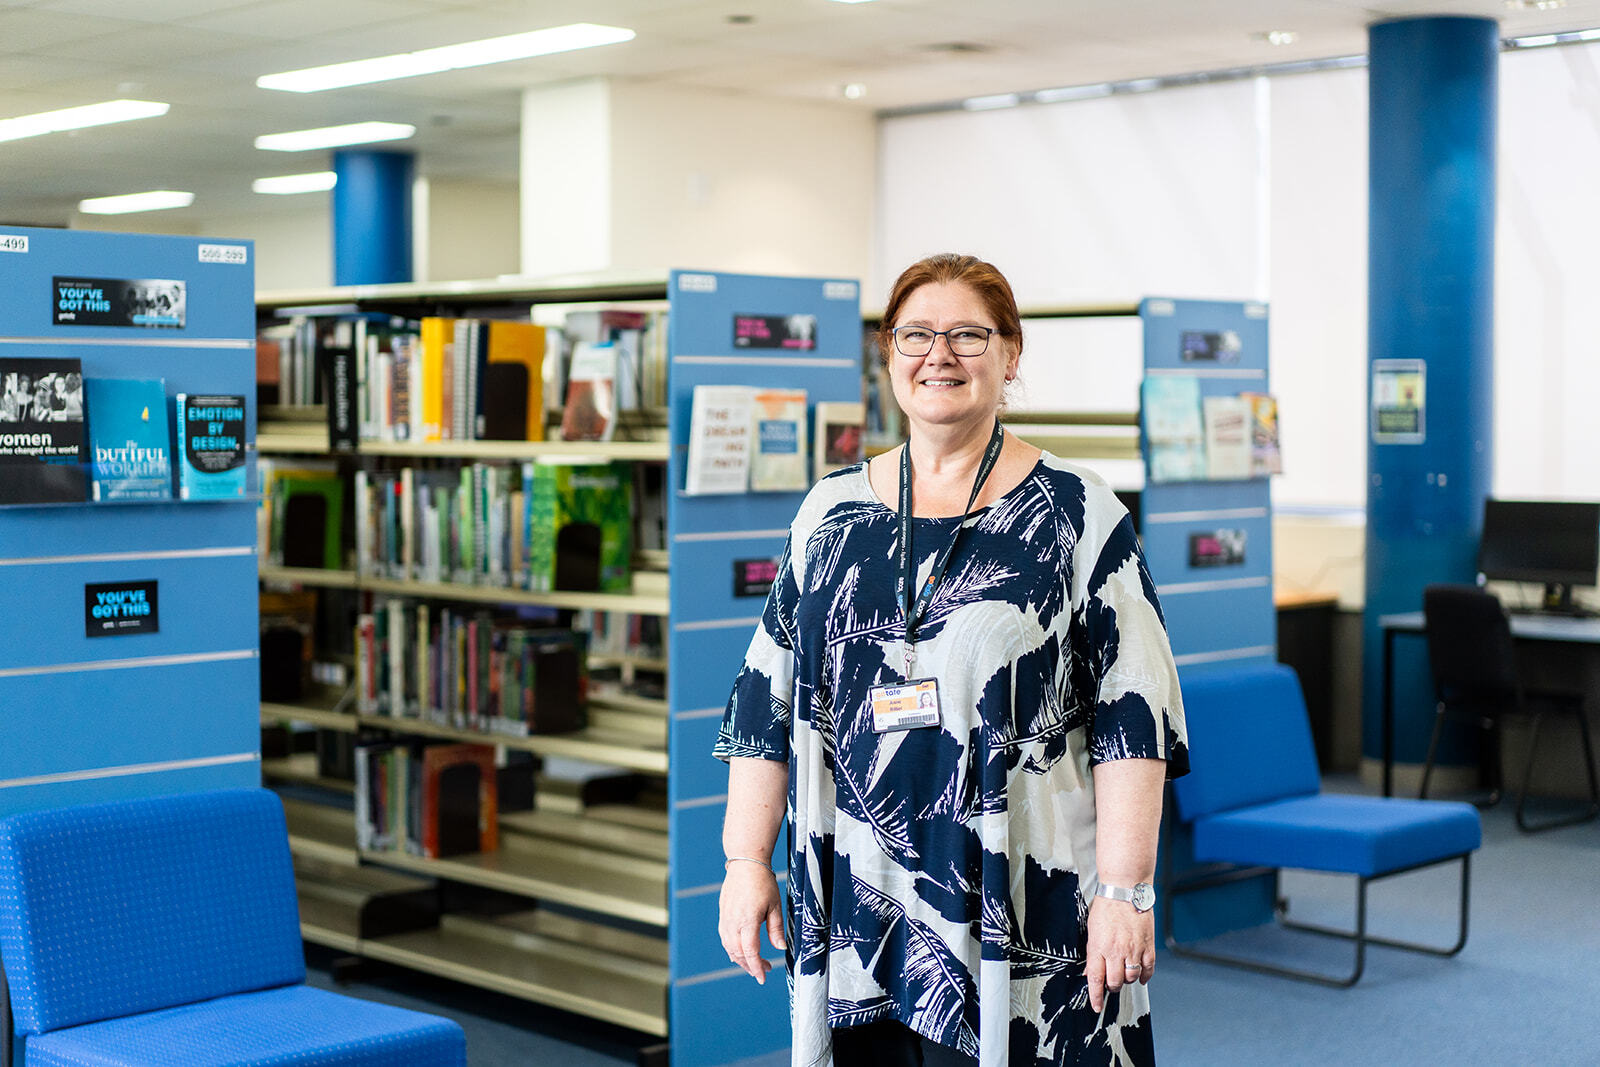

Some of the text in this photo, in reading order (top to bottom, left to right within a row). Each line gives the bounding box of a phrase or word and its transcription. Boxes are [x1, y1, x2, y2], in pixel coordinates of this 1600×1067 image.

[58, 288, 104, 299] YOU'VE
[58, 299, 111, 312] GOT THIS
[187, 407, 244, 421] EMOTION
[208, 421, 224, 435] BY
[0, 433, 52, 447] omen
[58, 445, 79, 455] world
[96, 590, 146, 605] YOU'VE
[92, 601, 151, 619] GOT THIS
